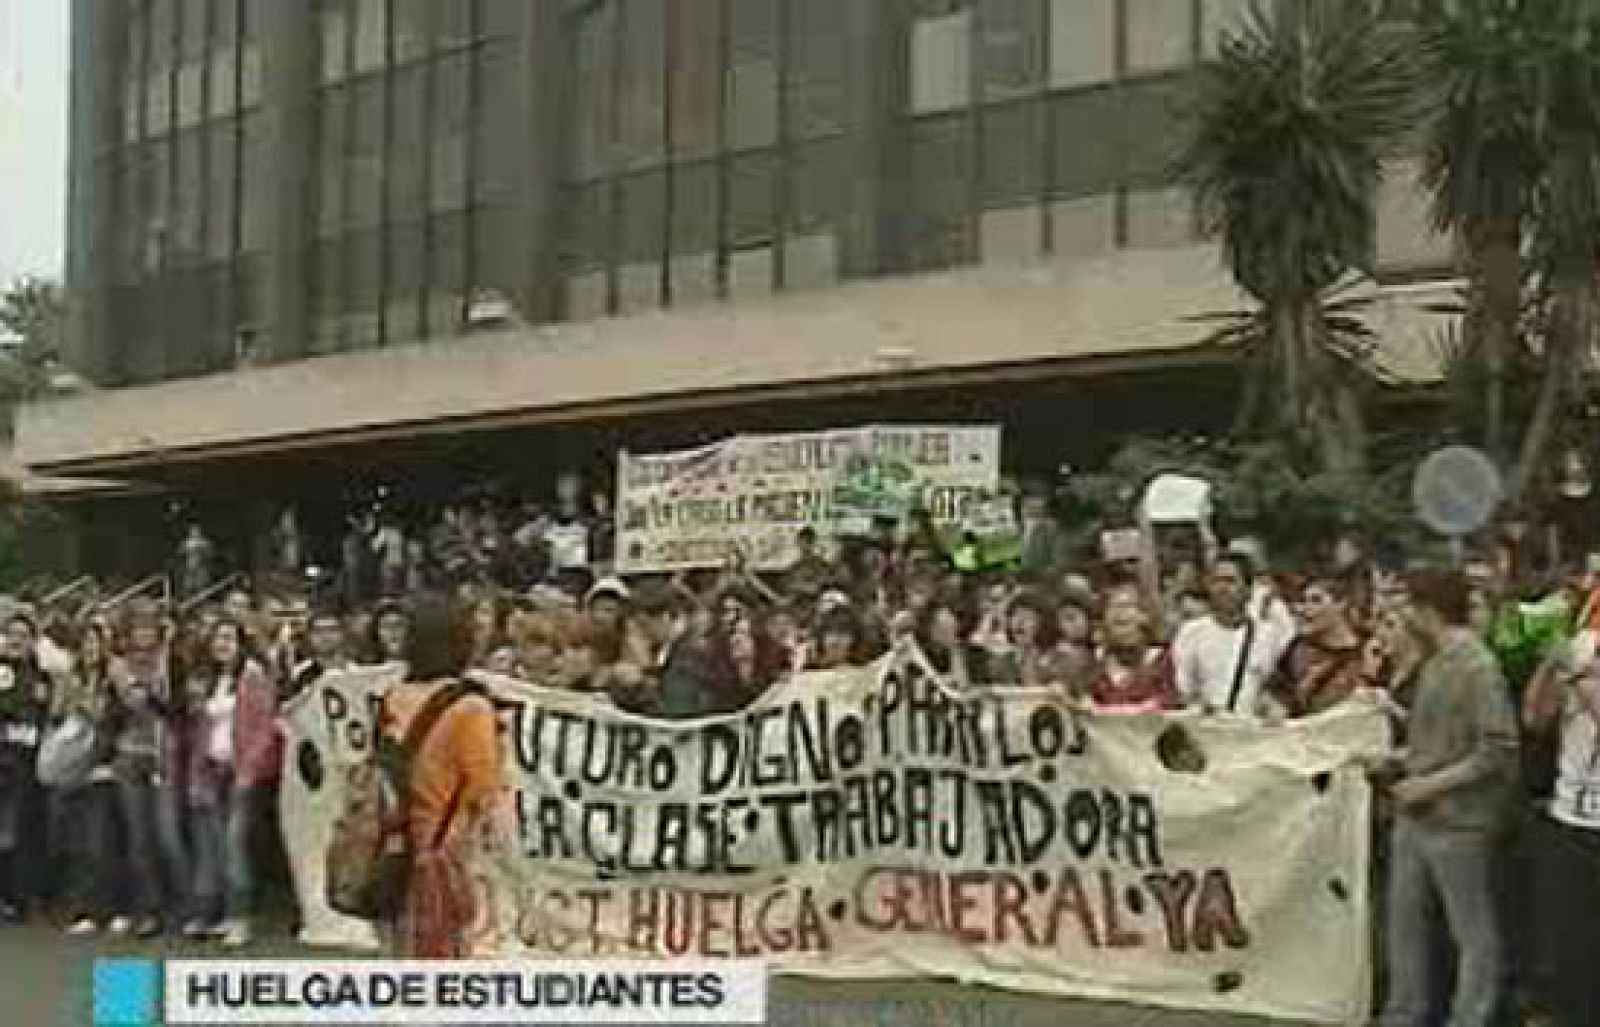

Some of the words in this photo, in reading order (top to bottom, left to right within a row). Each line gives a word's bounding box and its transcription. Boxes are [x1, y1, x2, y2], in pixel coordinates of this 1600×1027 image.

[698, 697, 864, 795] DIGNO
[582, 800, 757, 878] CLASE
[760, 767, 1163, 868] TRABAJADORA
[627, 884, 828, 958] HUELGA
[854, 866, 1144, 949] GENERAL
[1142, 867, 1250, 952] YA
